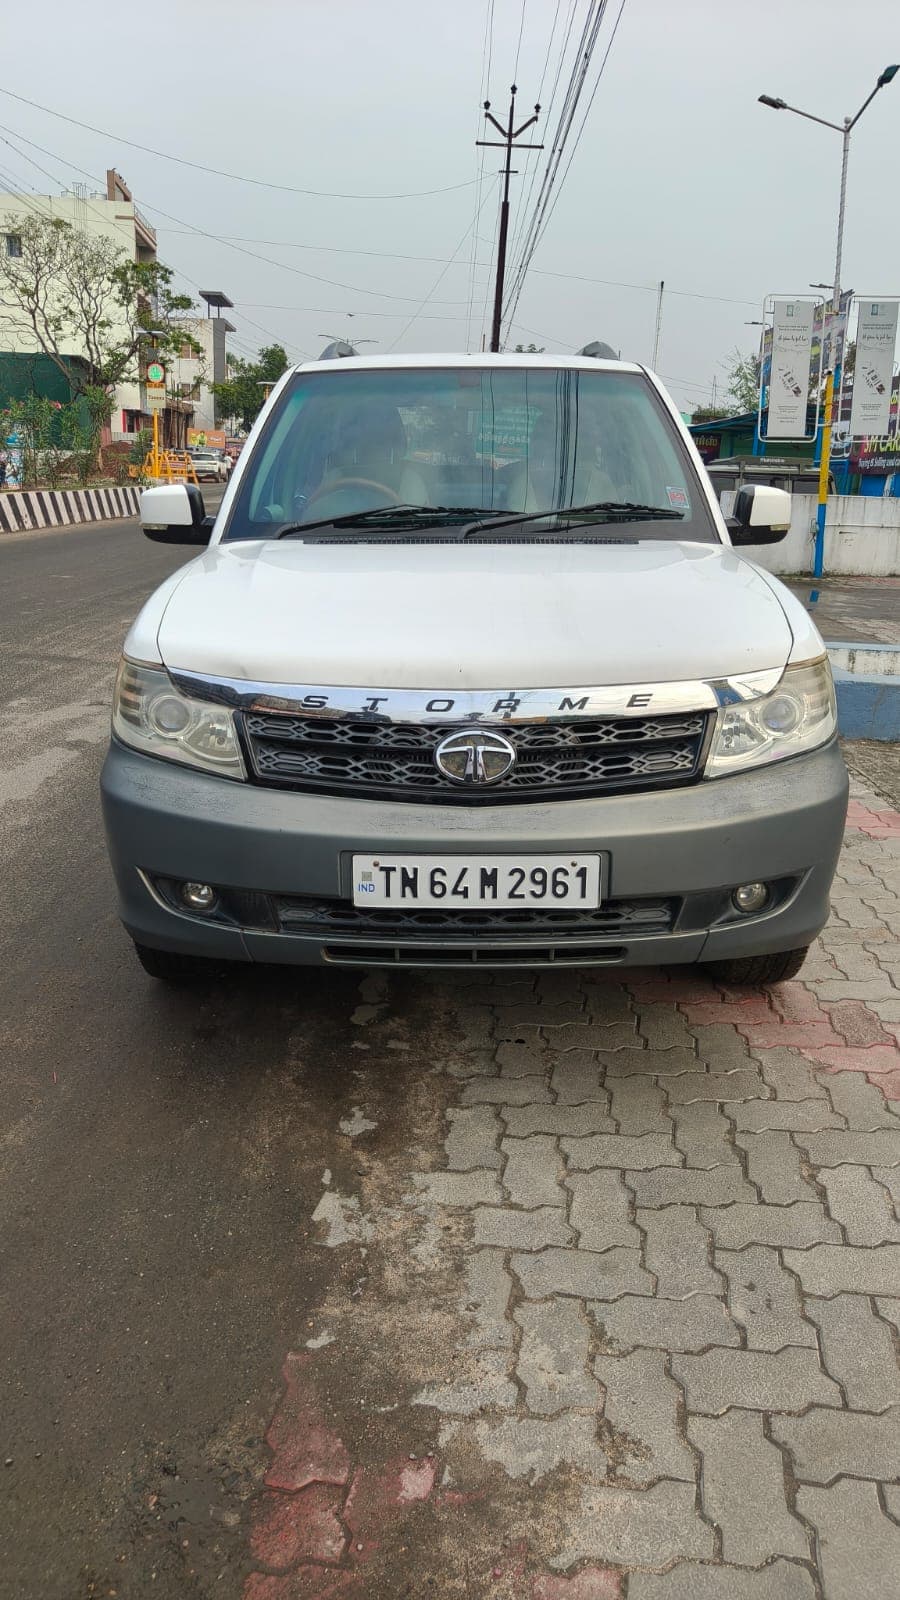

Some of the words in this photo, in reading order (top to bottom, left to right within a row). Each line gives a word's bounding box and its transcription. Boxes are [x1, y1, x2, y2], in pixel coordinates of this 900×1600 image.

[301, 692, 654, 713] STORME
[358, 883, 375, 892] IND
[379, 866, 418, 898] TN
[430, 866, 469, 899] 64
[480, 867, 498, 899] M
[508, 867, 588, 899] 2961
